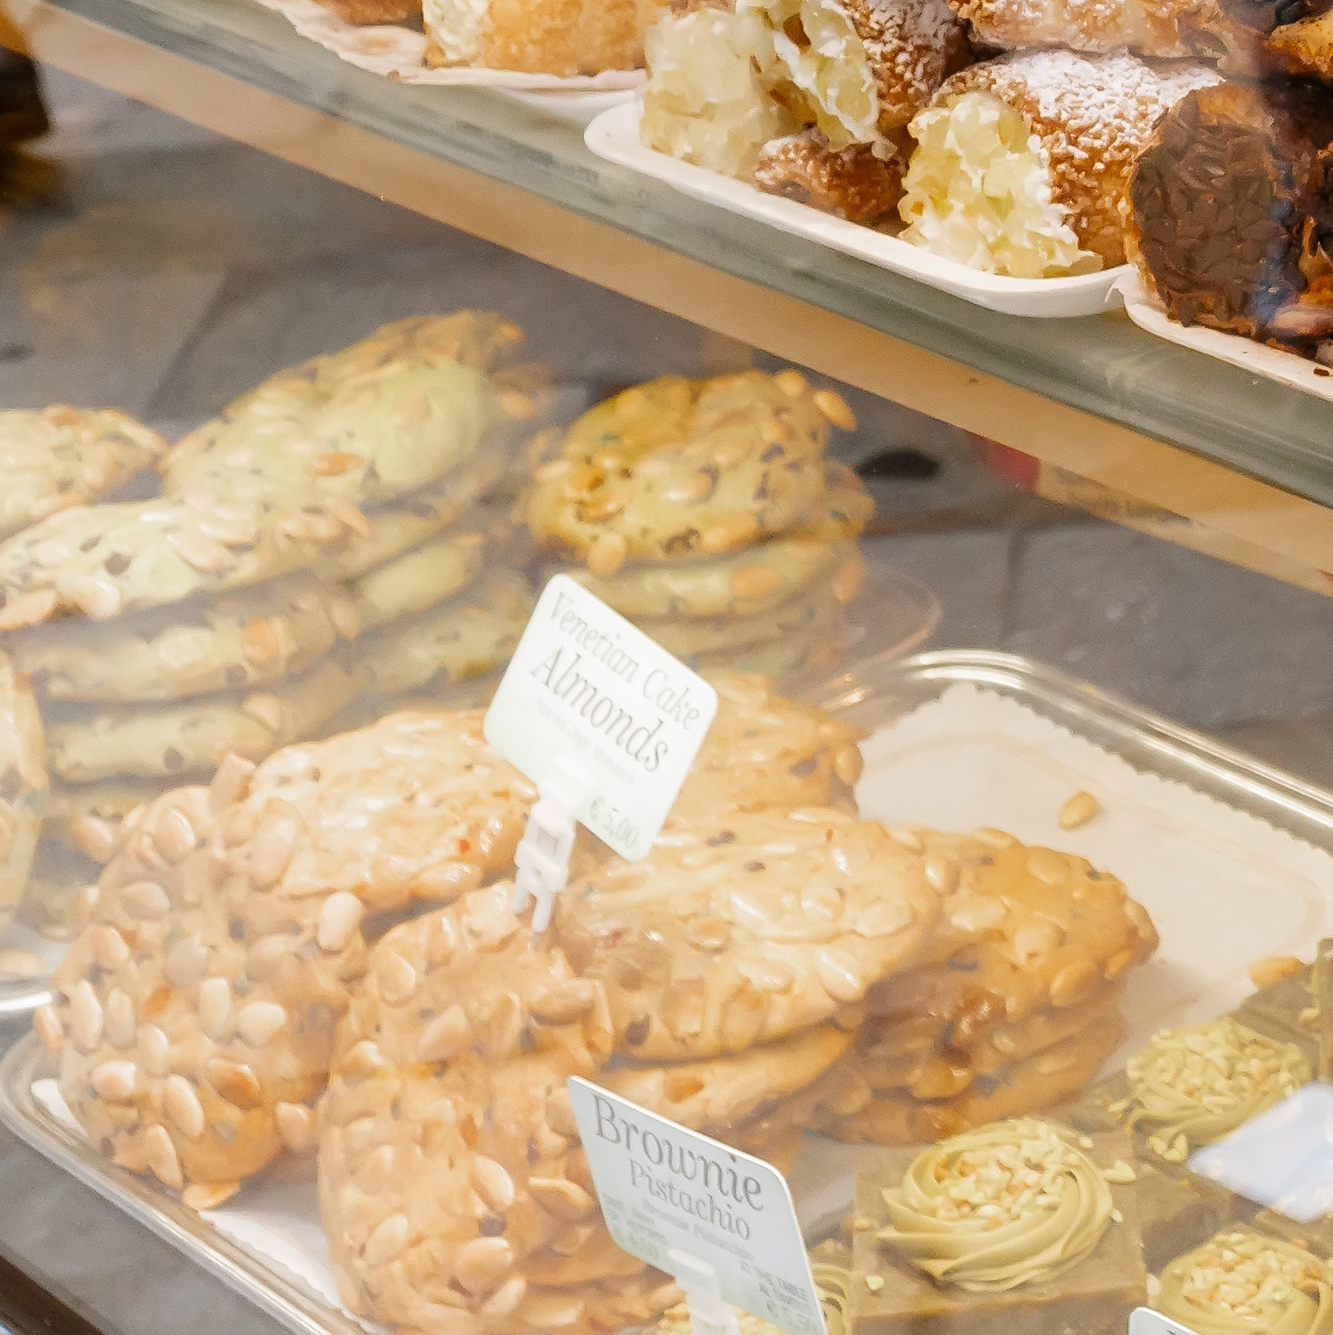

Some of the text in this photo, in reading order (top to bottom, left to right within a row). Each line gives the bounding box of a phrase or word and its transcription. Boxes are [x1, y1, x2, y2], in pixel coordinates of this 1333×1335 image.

[529, 645, 670, 773] Almonds
[550, 591, 700, 731] Venetian Cake
[591, 1092, 764, 1213] Brownie
[629, 1157, 752, 1242] Pistachio
